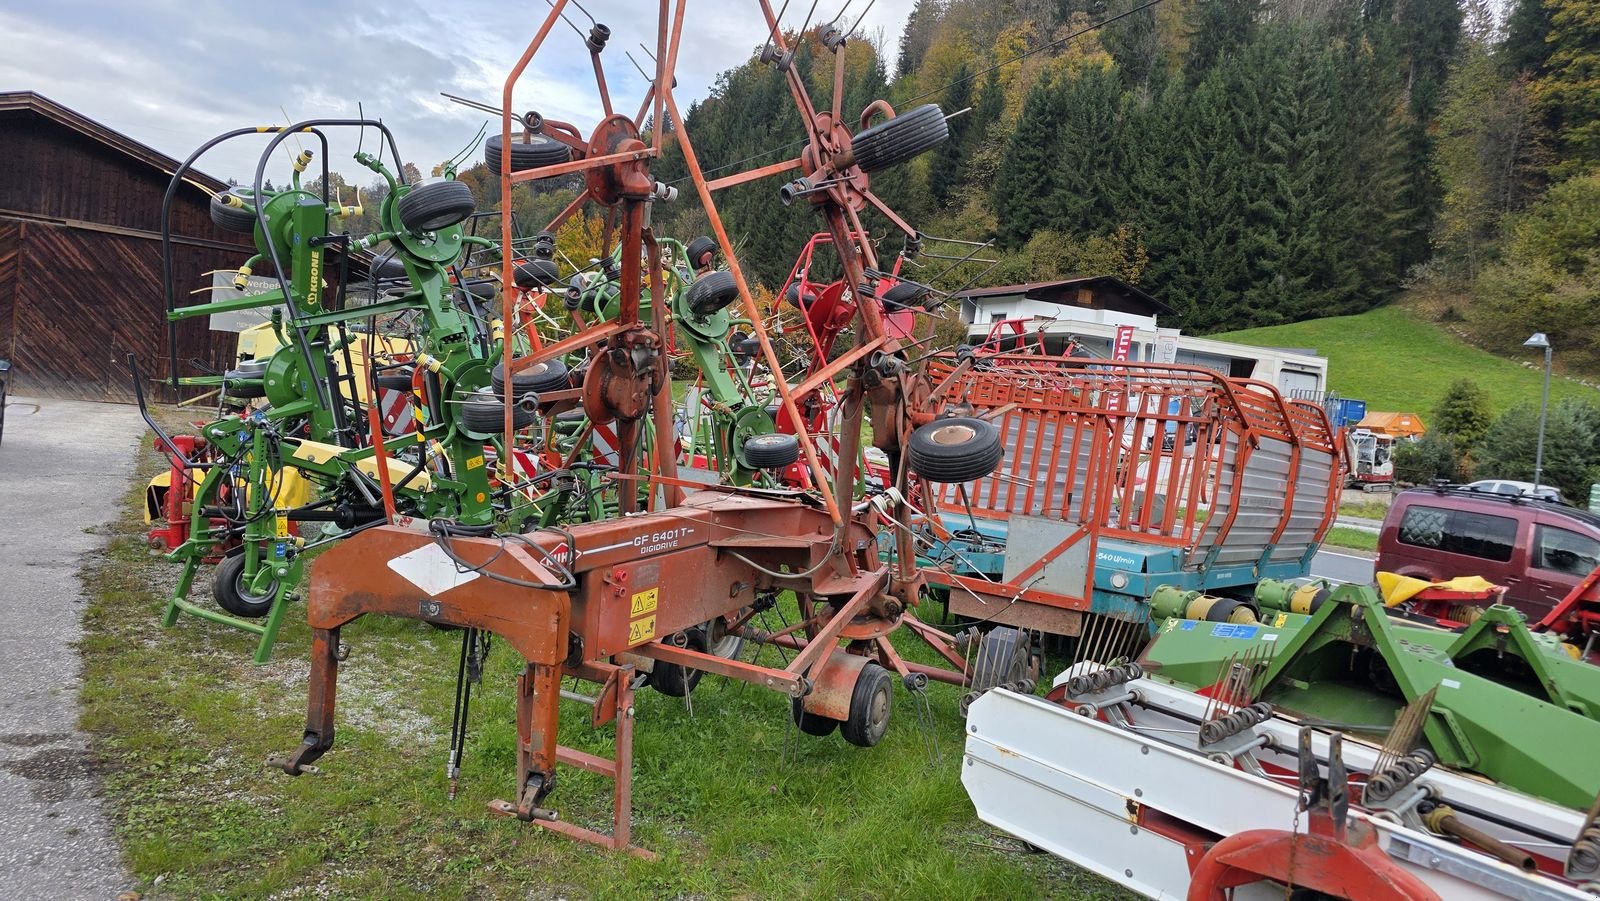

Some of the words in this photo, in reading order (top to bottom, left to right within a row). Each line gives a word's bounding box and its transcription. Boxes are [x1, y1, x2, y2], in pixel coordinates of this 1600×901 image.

[310, 251, 319, 292] KRONE
[633, 534, 650, 547] GF
[640, 540, 679, 555] DIGIDRIVE
